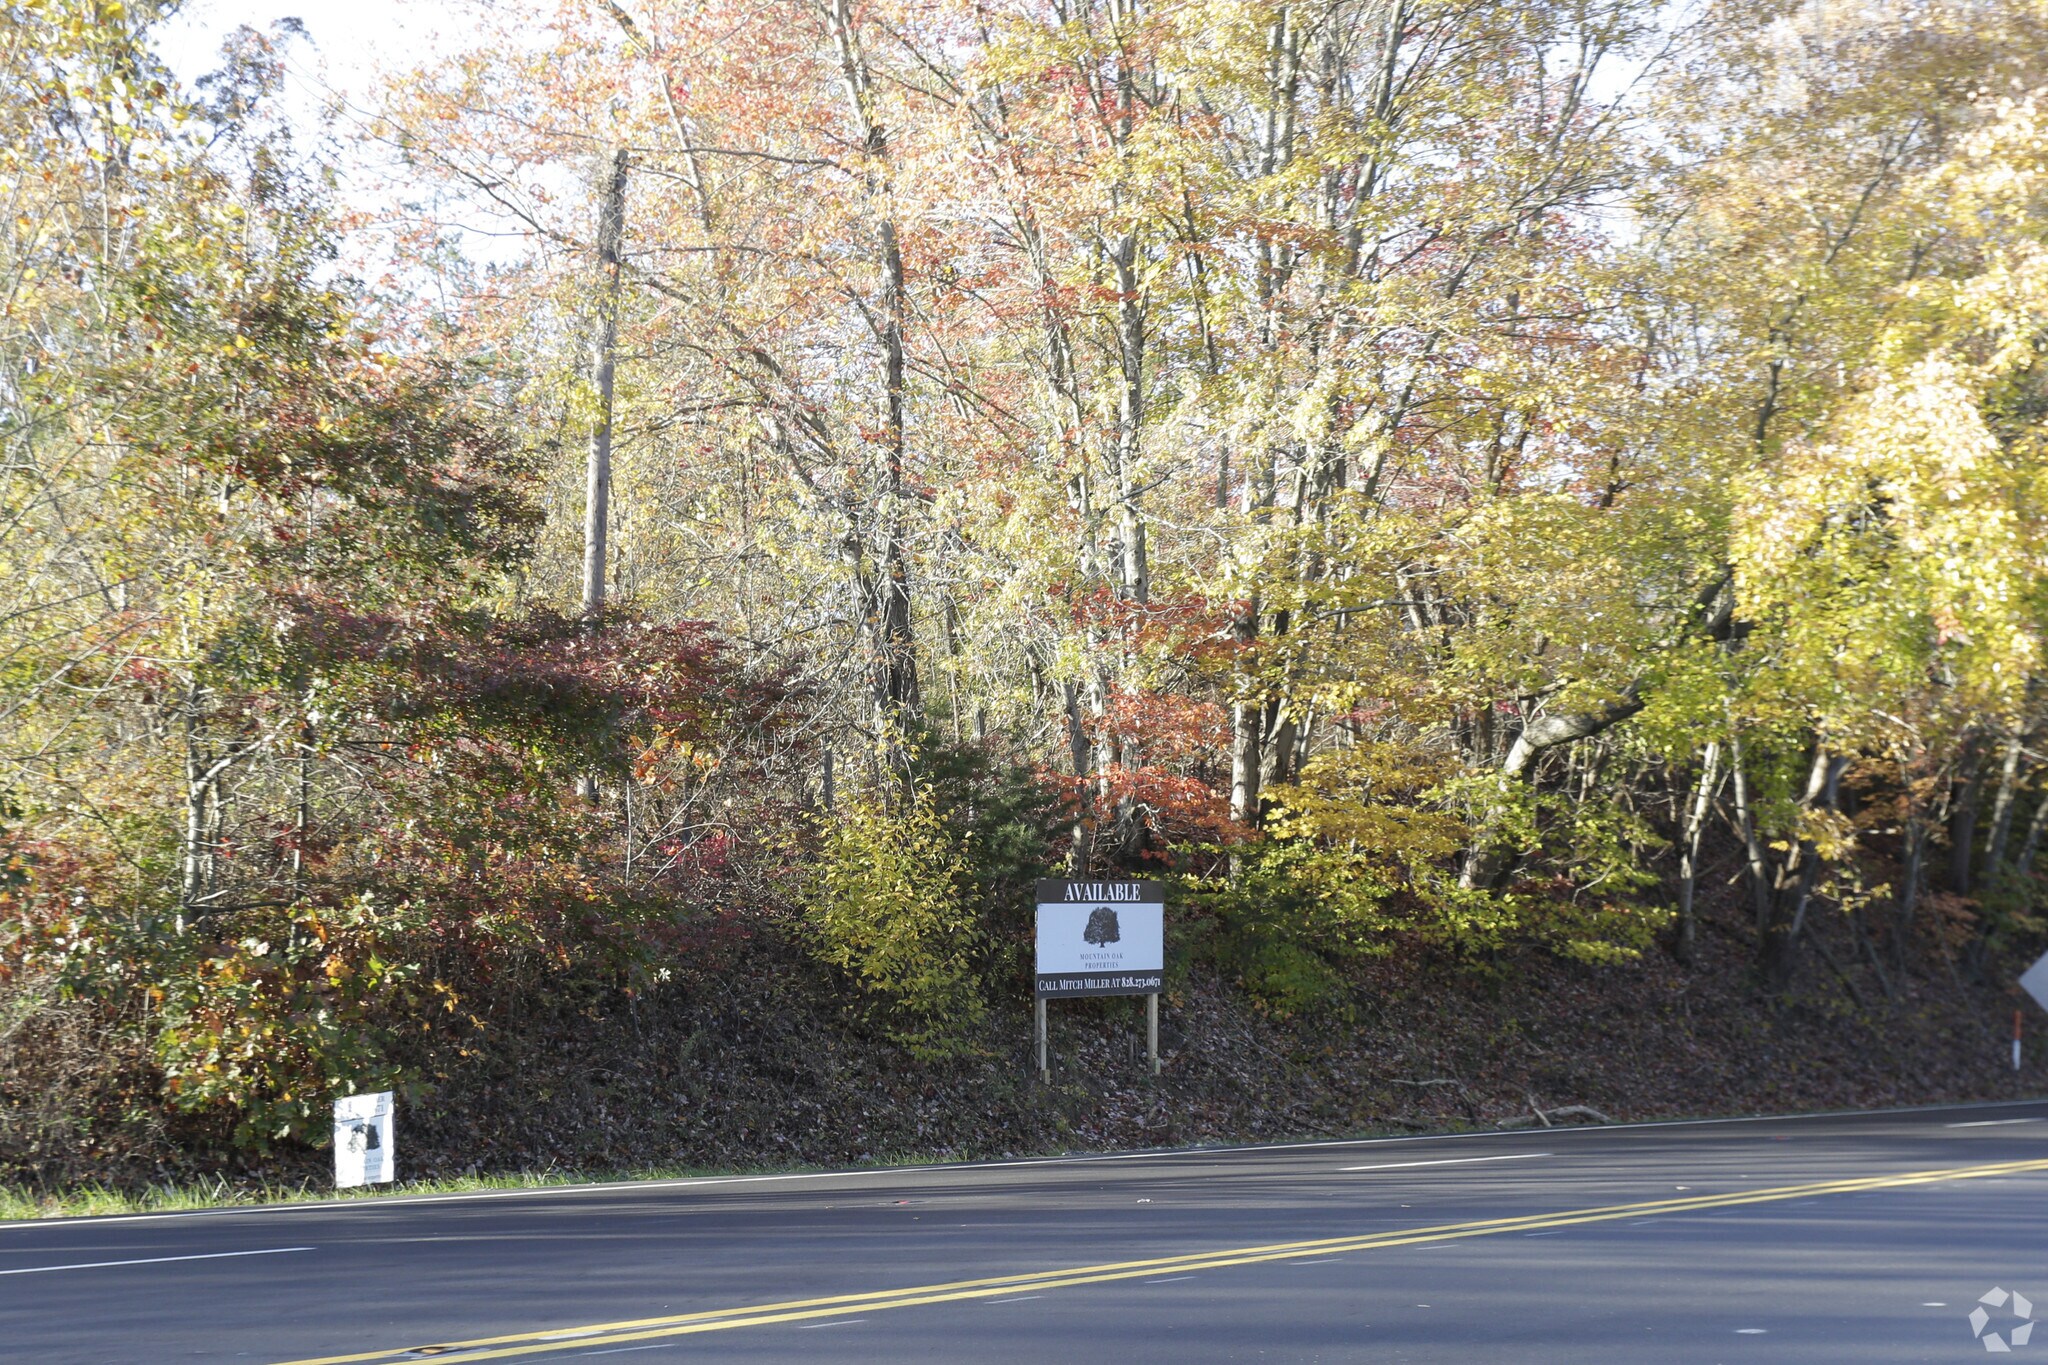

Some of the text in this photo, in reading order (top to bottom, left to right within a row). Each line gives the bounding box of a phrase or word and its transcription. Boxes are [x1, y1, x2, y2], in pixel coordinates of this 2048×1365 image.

[1064, 883, 1141, 901] AVAILABLE
[1038, 979, 1058, 991] CALL
[1059, 979, 1083, 990] MITCH
[1084, 978, 1110, 989] MILLER
[1121, 976, 1161, 989] 828.273.0671
